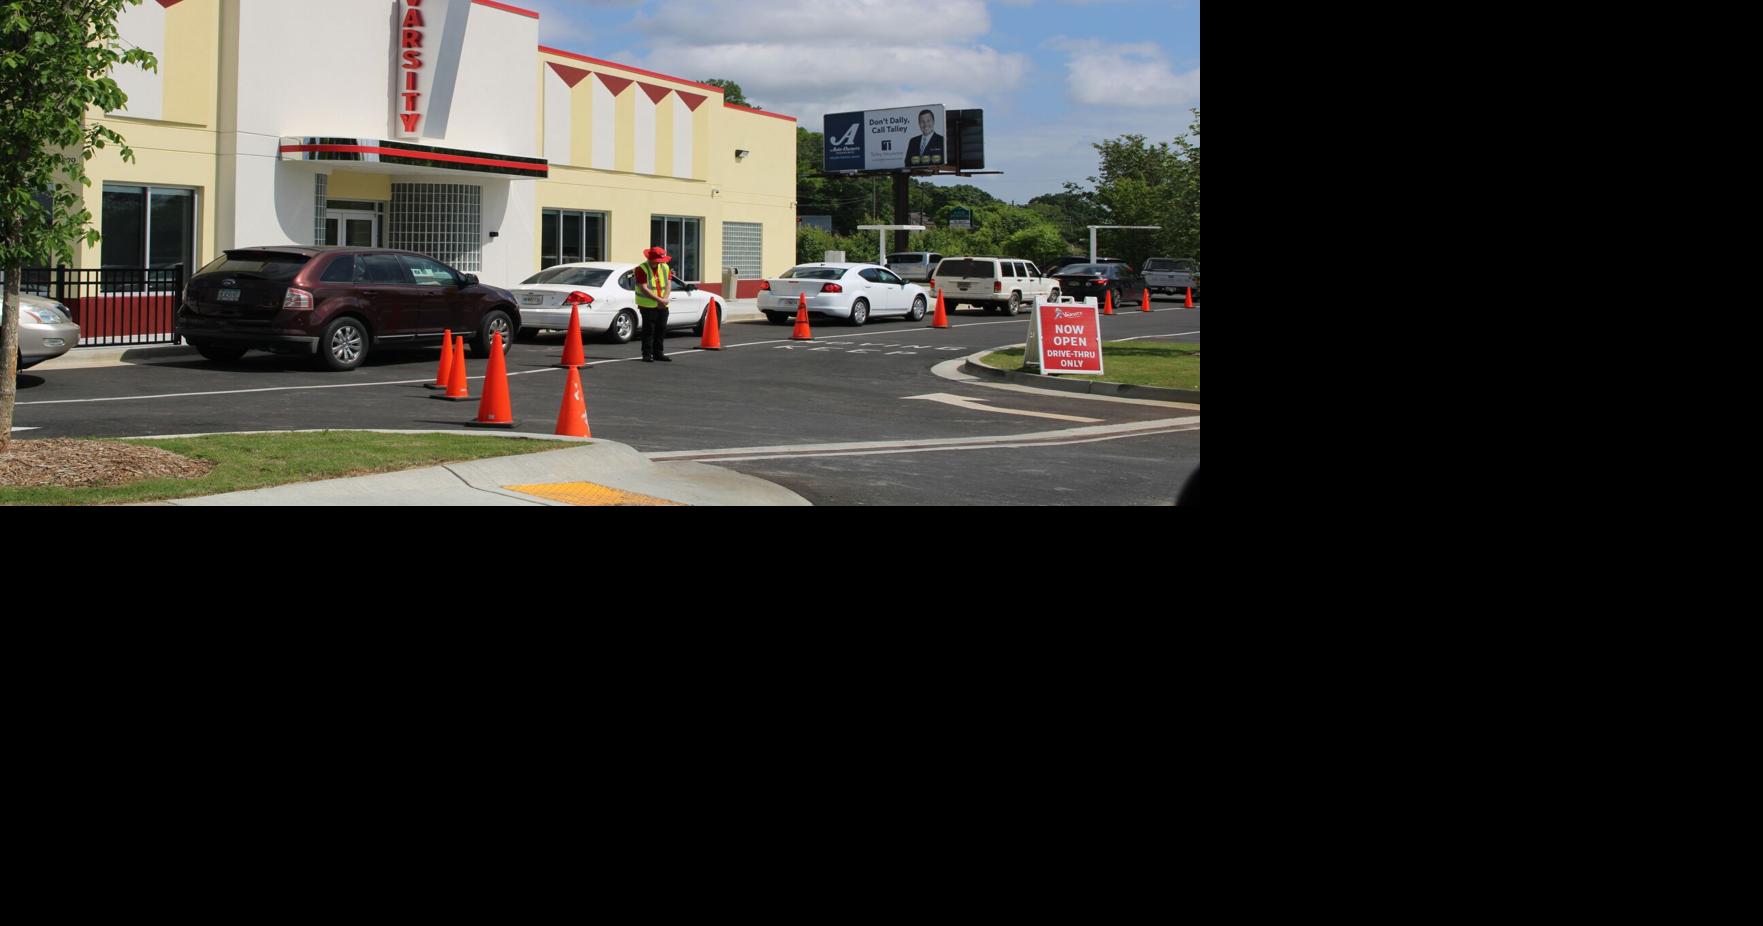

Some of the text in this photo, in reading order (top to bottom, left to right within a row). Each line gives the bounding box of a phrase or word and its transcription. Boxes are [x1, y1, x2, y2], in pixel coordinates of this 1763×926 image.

[869, 118, 888, 126] Don't
[887, 125, 908, 133] Talley
[1055, 324, 1084, 334] NOW
[1053, 336, 1087, 346] OPEN
[1047, 349, 1096, 359] DRIVE-THRU
[1060, 359, 1084, 368] ONLY
